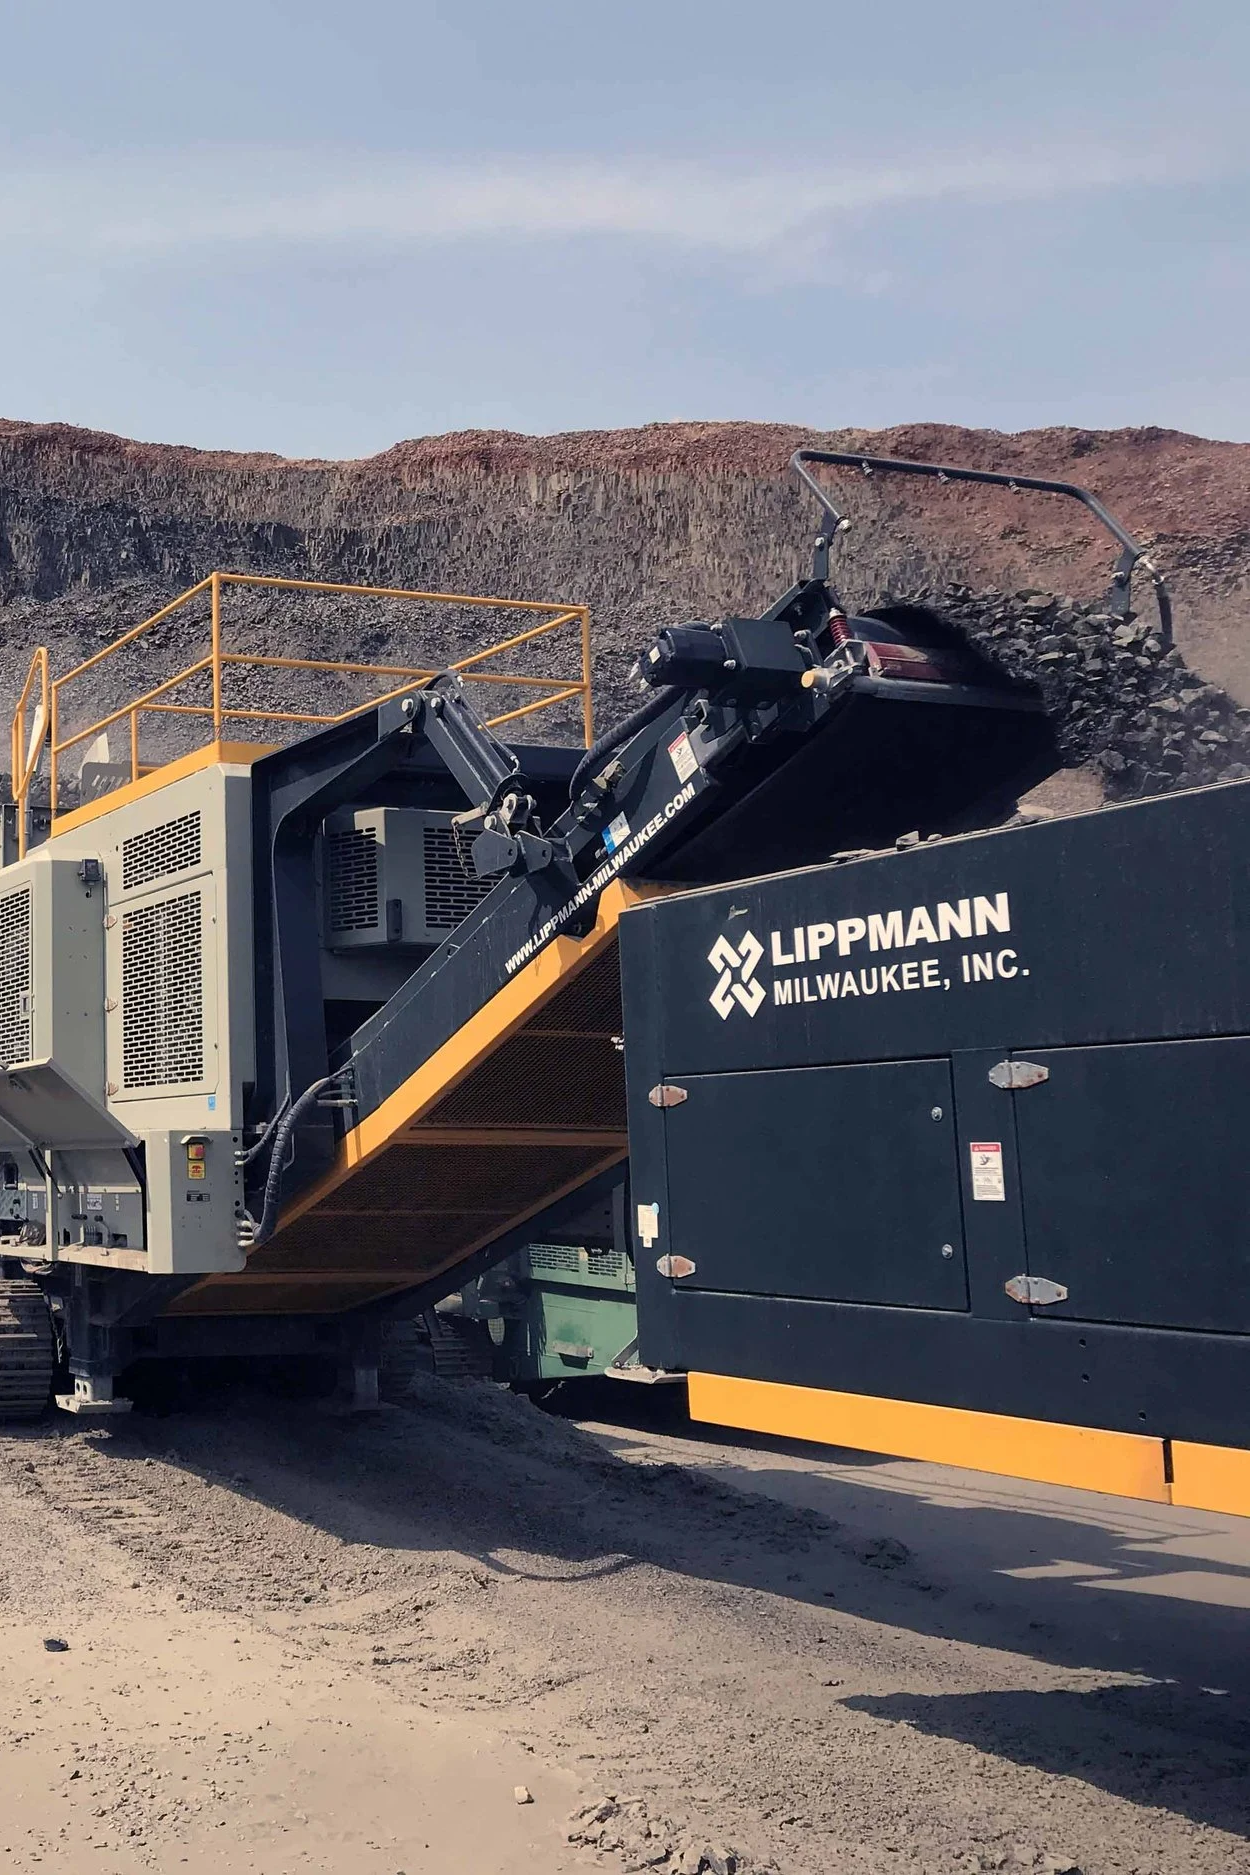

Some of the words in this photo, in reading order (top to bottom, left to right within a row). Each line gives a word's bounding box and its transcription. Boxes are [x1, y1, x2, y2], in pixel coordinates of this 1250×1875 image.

[505, 782, 696, 974] WWW.LIPPMANN-MILWAUKEE.COM
[771, 892, 1011, 966] LIPPMANN
[773, 958, 950, 1006] MILWAUKEE,
[962, 949, 1030, 983] INC.
